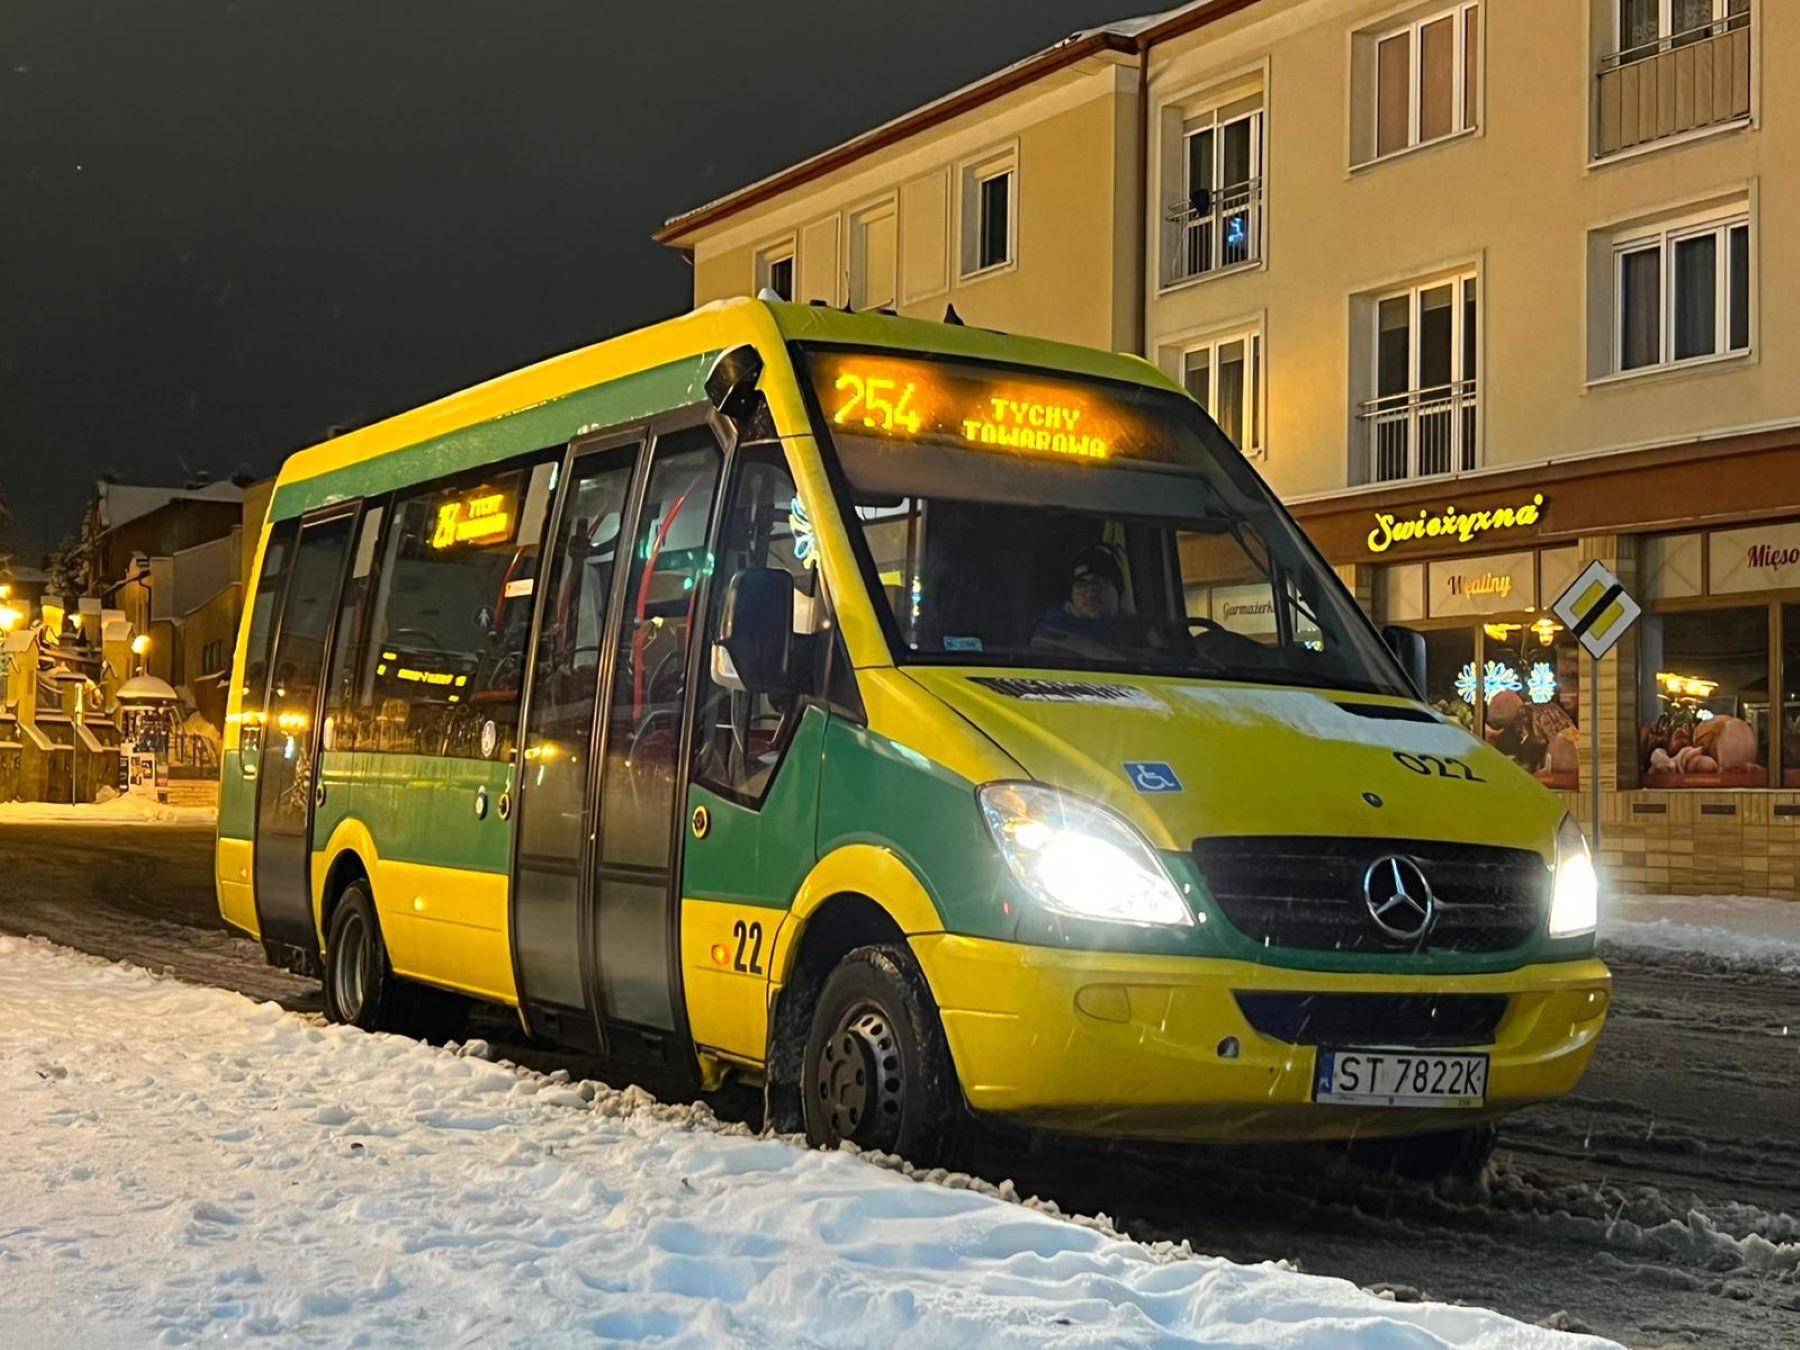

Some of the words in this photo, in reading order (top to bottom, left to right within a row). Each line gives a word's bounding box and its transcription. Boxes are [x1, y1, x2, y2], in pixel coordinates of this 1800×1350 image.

[834, 373, 920, 433] 254
[990, 398, 1080, 431] TYCHY
[963, 420, 1106, 458] TOWAROWA
[1747, 544, 1800, 571] Mięso
[1223, 600, 1274, 621] Garmażerk
[1392, 751, 1487, 783] 022
[733, 920, 763, 975] 22
[1338, 1056, 1384, 1093] ST
[1393, 1058, 1482, 1095] 7822K
